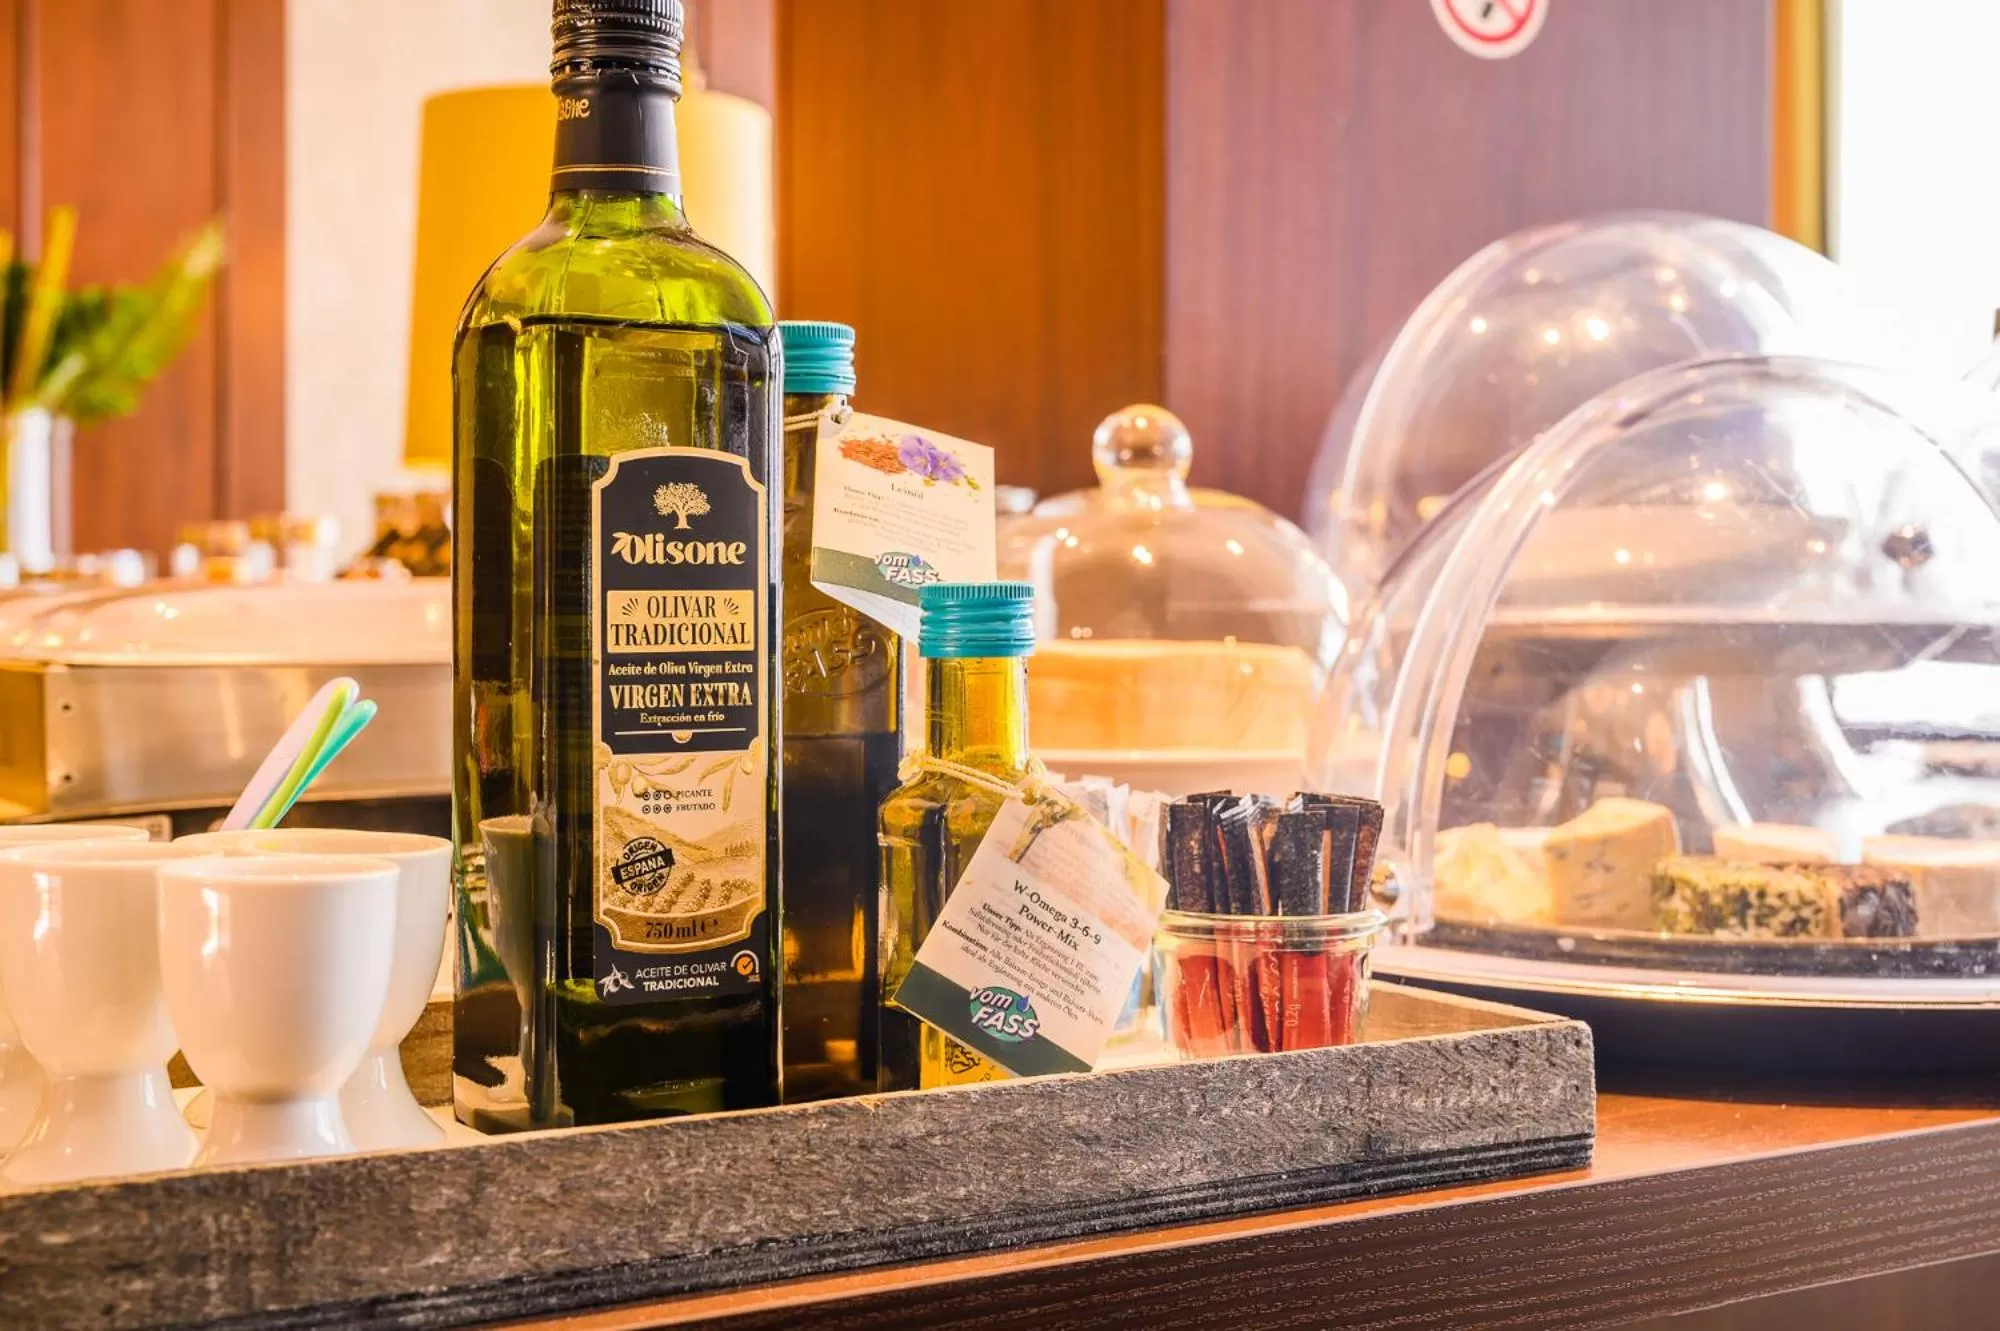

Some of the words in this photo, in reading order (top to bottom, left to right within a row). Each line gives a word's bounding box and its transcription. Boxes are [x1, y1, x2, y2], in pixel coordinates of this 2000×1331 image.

[612, 532, 747, 566] Olisone
[873, 553, 909, 567] vom
[884, 566, 939, 585] FASS
[647, 596, 717, 619] OLIVAR
[611, 622, 750, 646] TRADICIONAL
[608, 663, 642, 676] Aceite
[644, 662, 657, 675] de
[659, 661, 686, 675] Oliva
[687, 660, 722, 678] Virgen
[724, 660, 753, 674] Extra
[609, 683, 685, 709] VIRGEN
[690, 681, 753, 707] EXTRA
[640, 712, 692, 725] Extracción
[694, 711, 706, 722] en
[675, 789, 713, 799] PICANTE
[675, 802, 716, 813] FRUTADO
[623, 840, 659, 862] ORIGEN
[1013, 880, 1068, 923] W-Omega
[1069, 918, 1101, 944] 3-6-9
[644, 921, 673, 939] 750
[676, 920, 697, 938] ml
[1019, 904, 1081, 950] Power-Mix
[635, 966, 672, 979] ACEITE
[673, 965, 689, 976] DE
[690, 962, 728, 975] OLIVAR
[643, 976, 719, 992] TRADICIONAL
[969, 985, 1012, 1009] vom
[969, 1006, 1040, 1038] FASS
